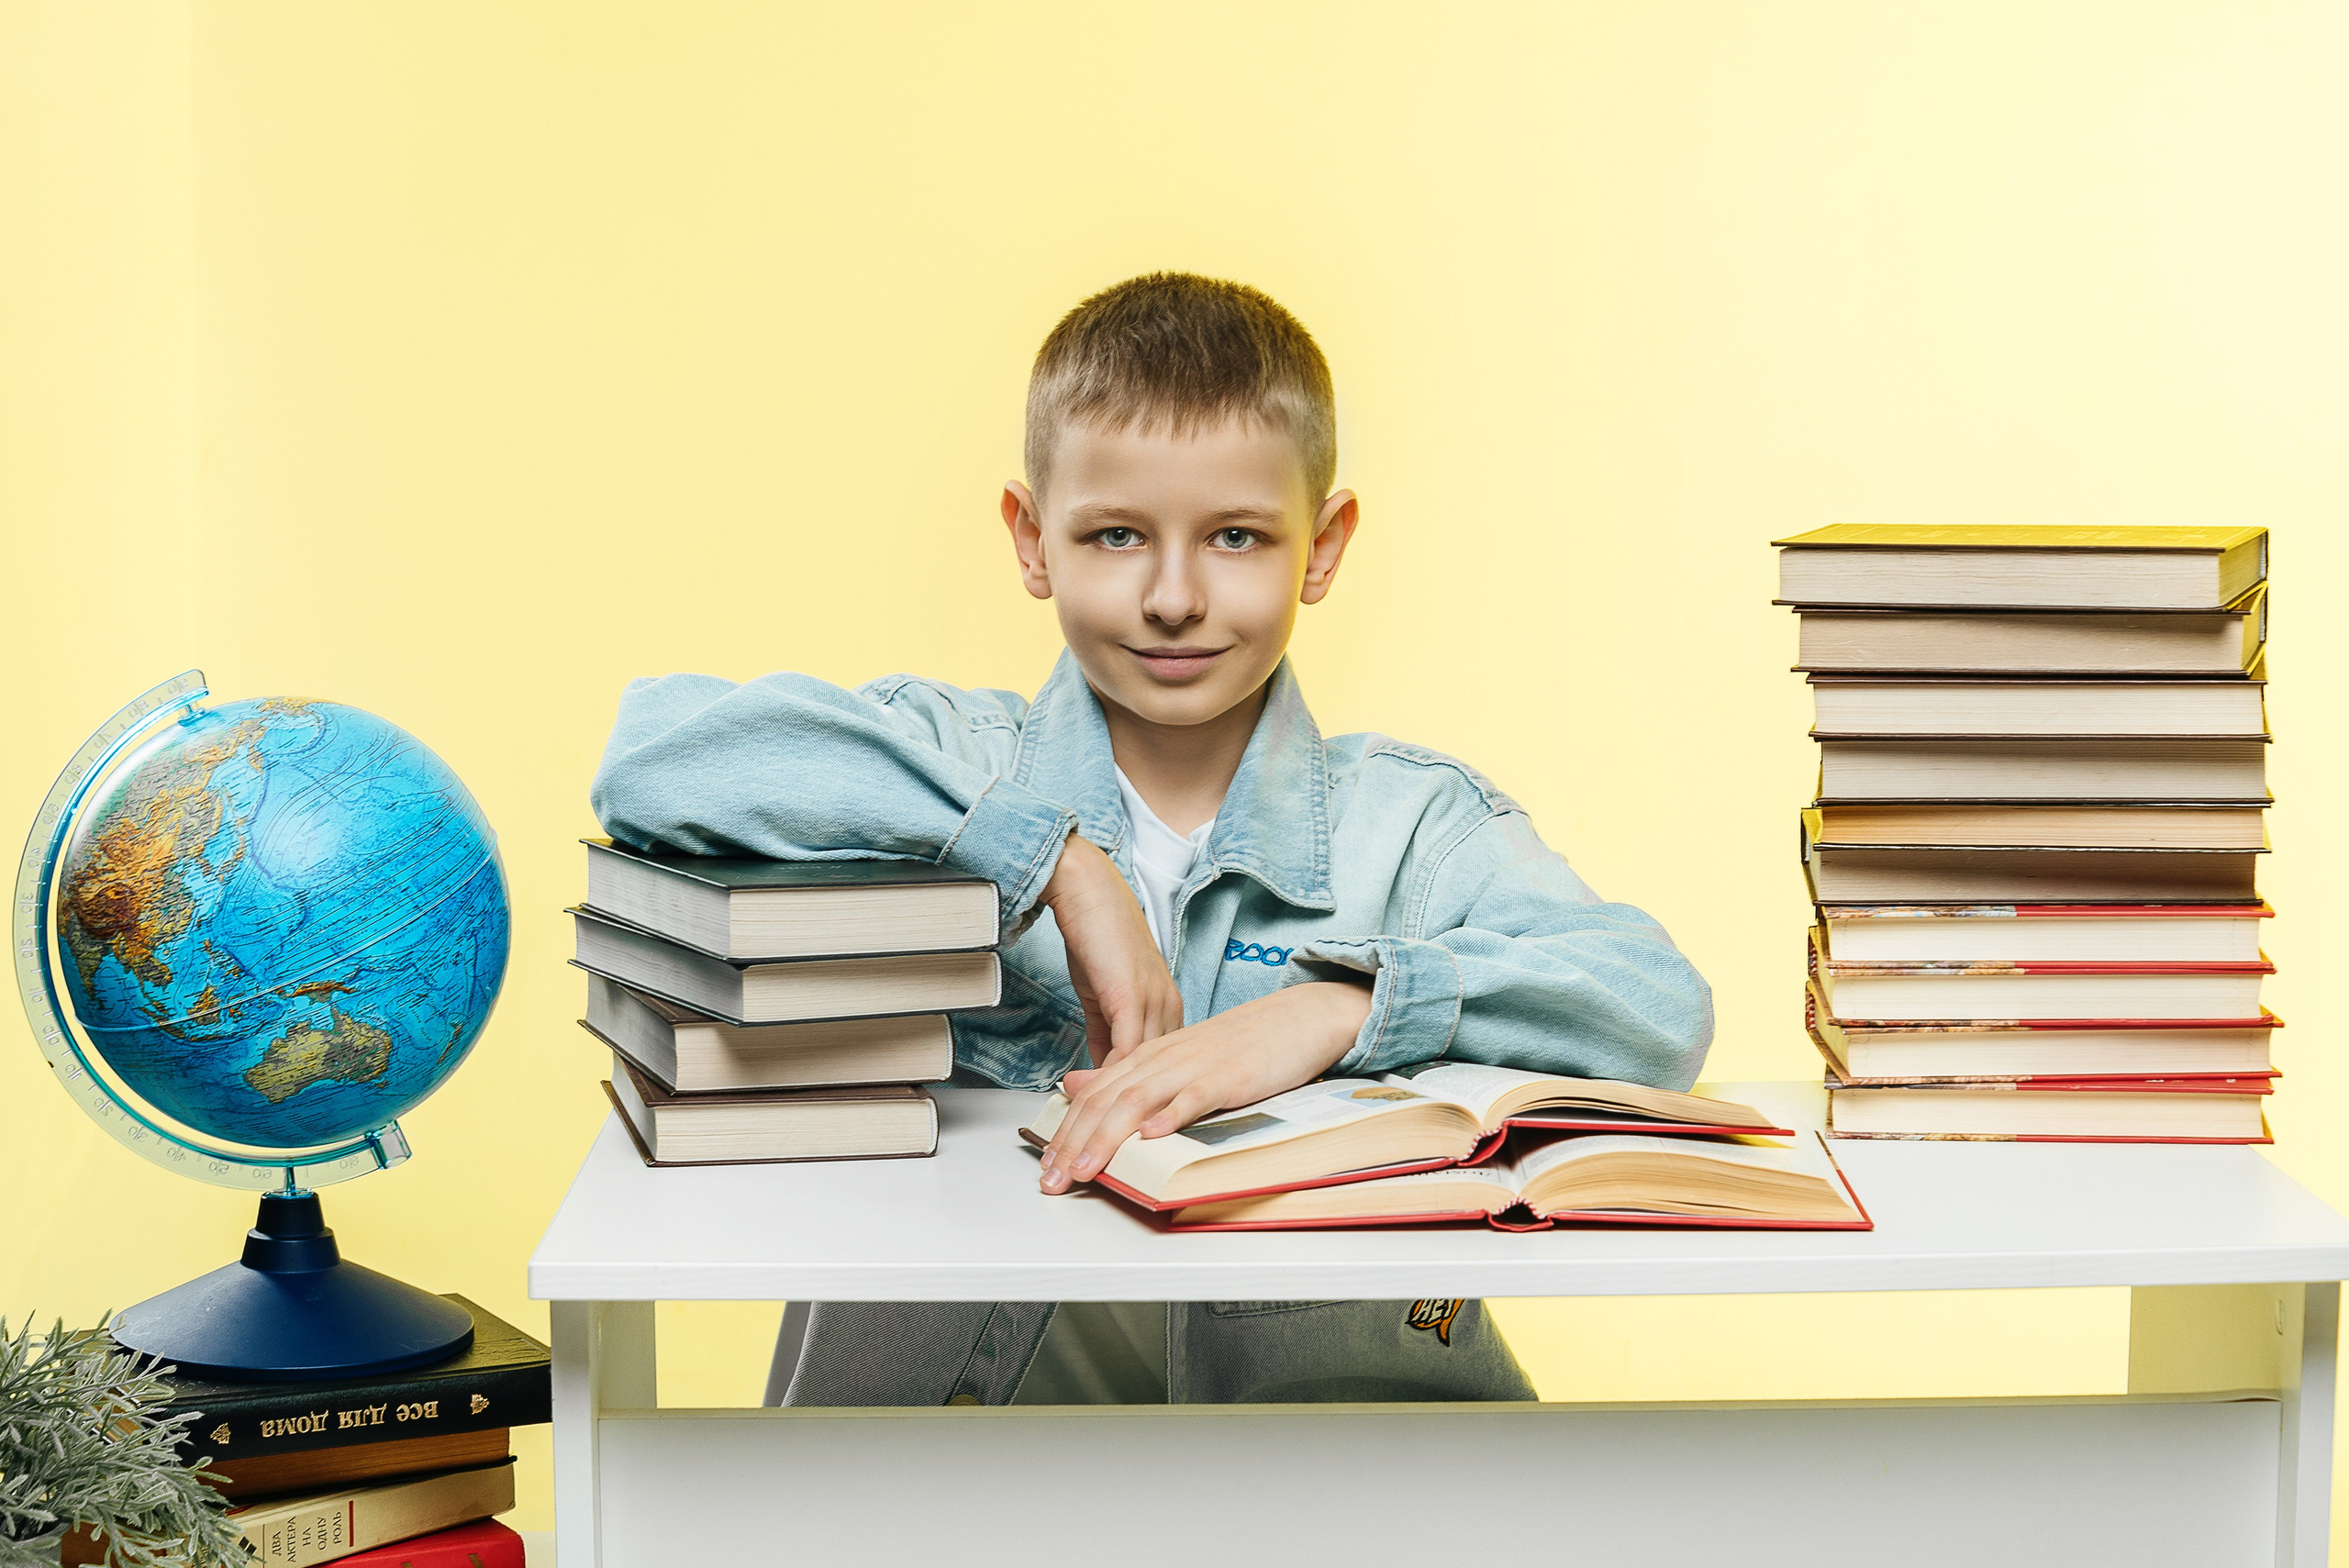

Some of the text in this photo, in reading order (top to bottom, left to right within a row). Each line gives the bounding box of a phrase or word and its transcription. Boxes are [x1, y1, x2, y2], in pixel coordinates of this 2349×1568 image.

[260, 1409, 329, 1438] дома
[338, 1403, 387, 1429] для
[286, 1516, 296, 1562] АКТЕРА
[302, 1527, 311, 1547] НА
[317, 1517, 328, 1551] ОДНУ
[332, 1511, 342, 1544] РОЛЬ
[272, 1530, 282, 1556] ДВА
